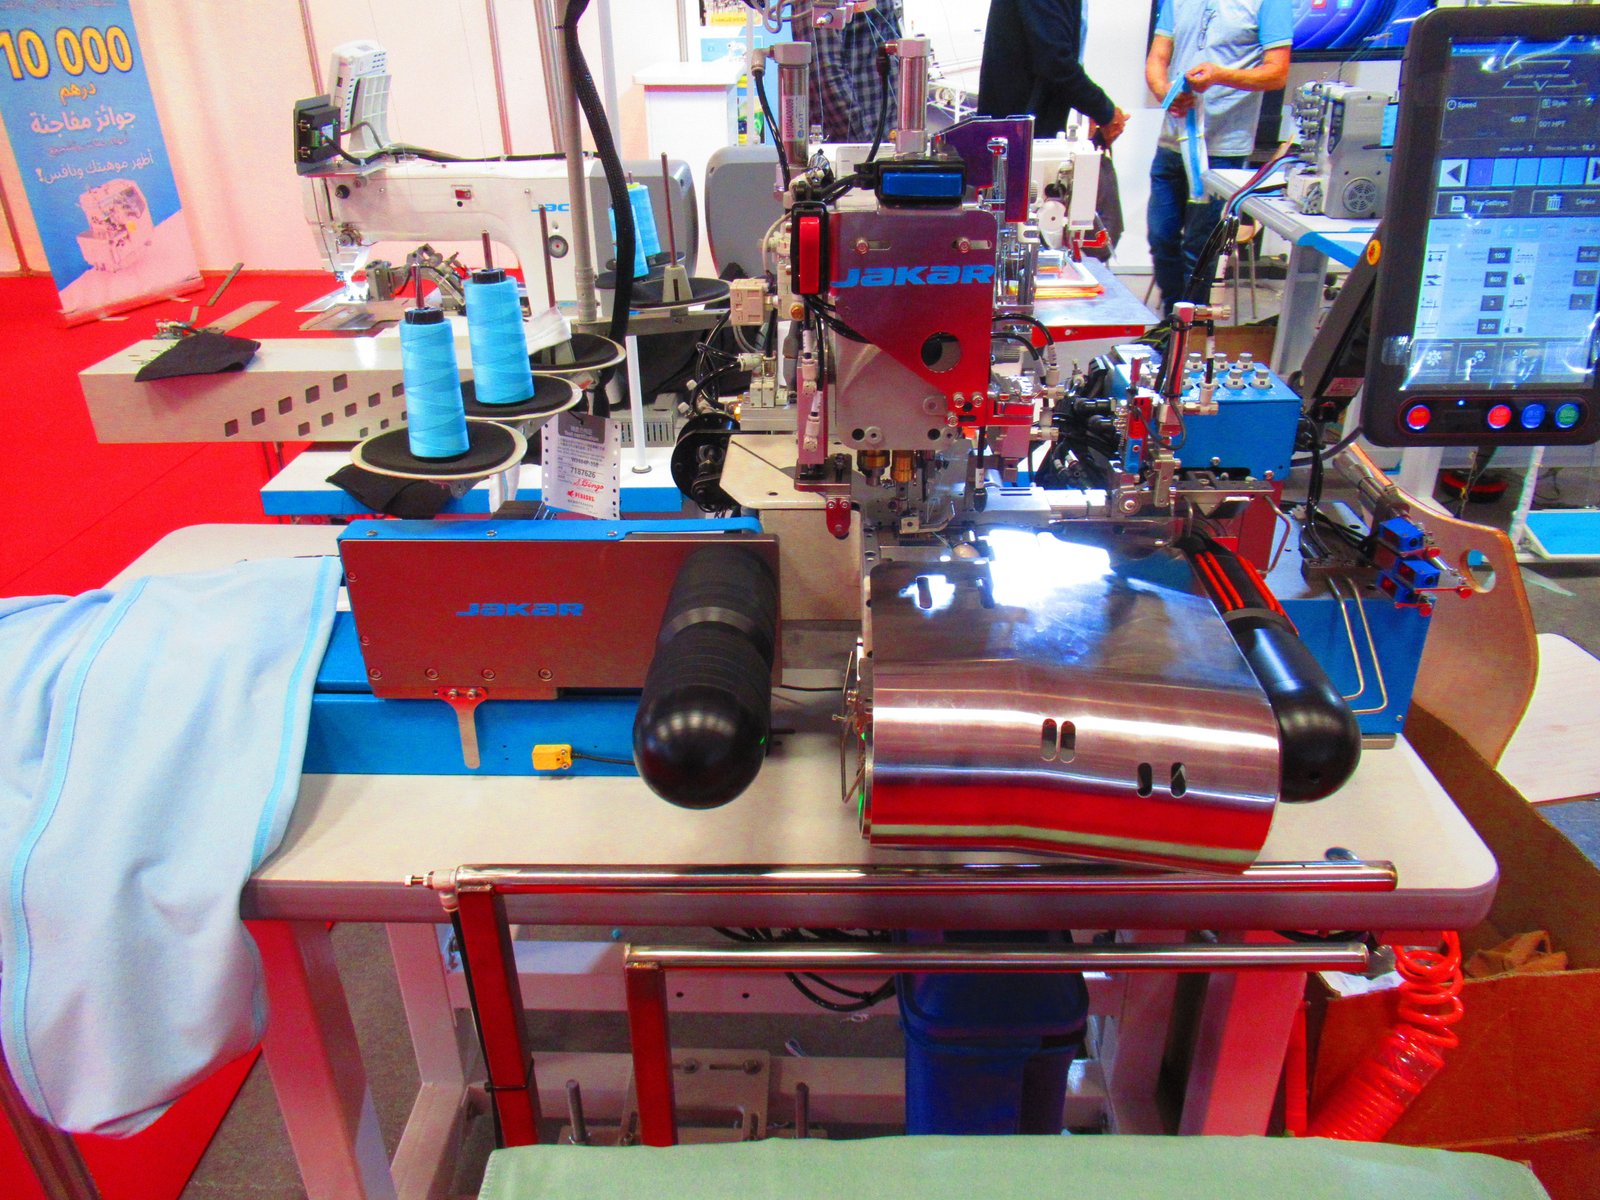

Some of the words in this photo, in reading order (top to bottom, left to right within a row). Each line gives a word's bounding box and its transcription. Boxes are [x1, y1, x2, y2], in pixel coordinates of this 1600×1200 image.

[0, 28, 50, 81] 10
[55, 25, 134, 77] 000
[58, 82, 97, 107] درهم
[29, 110, 92, 138] مفاجئة
[96, 104, 136, 132] جوائز
[131, 146, 155, 172] أظهر
